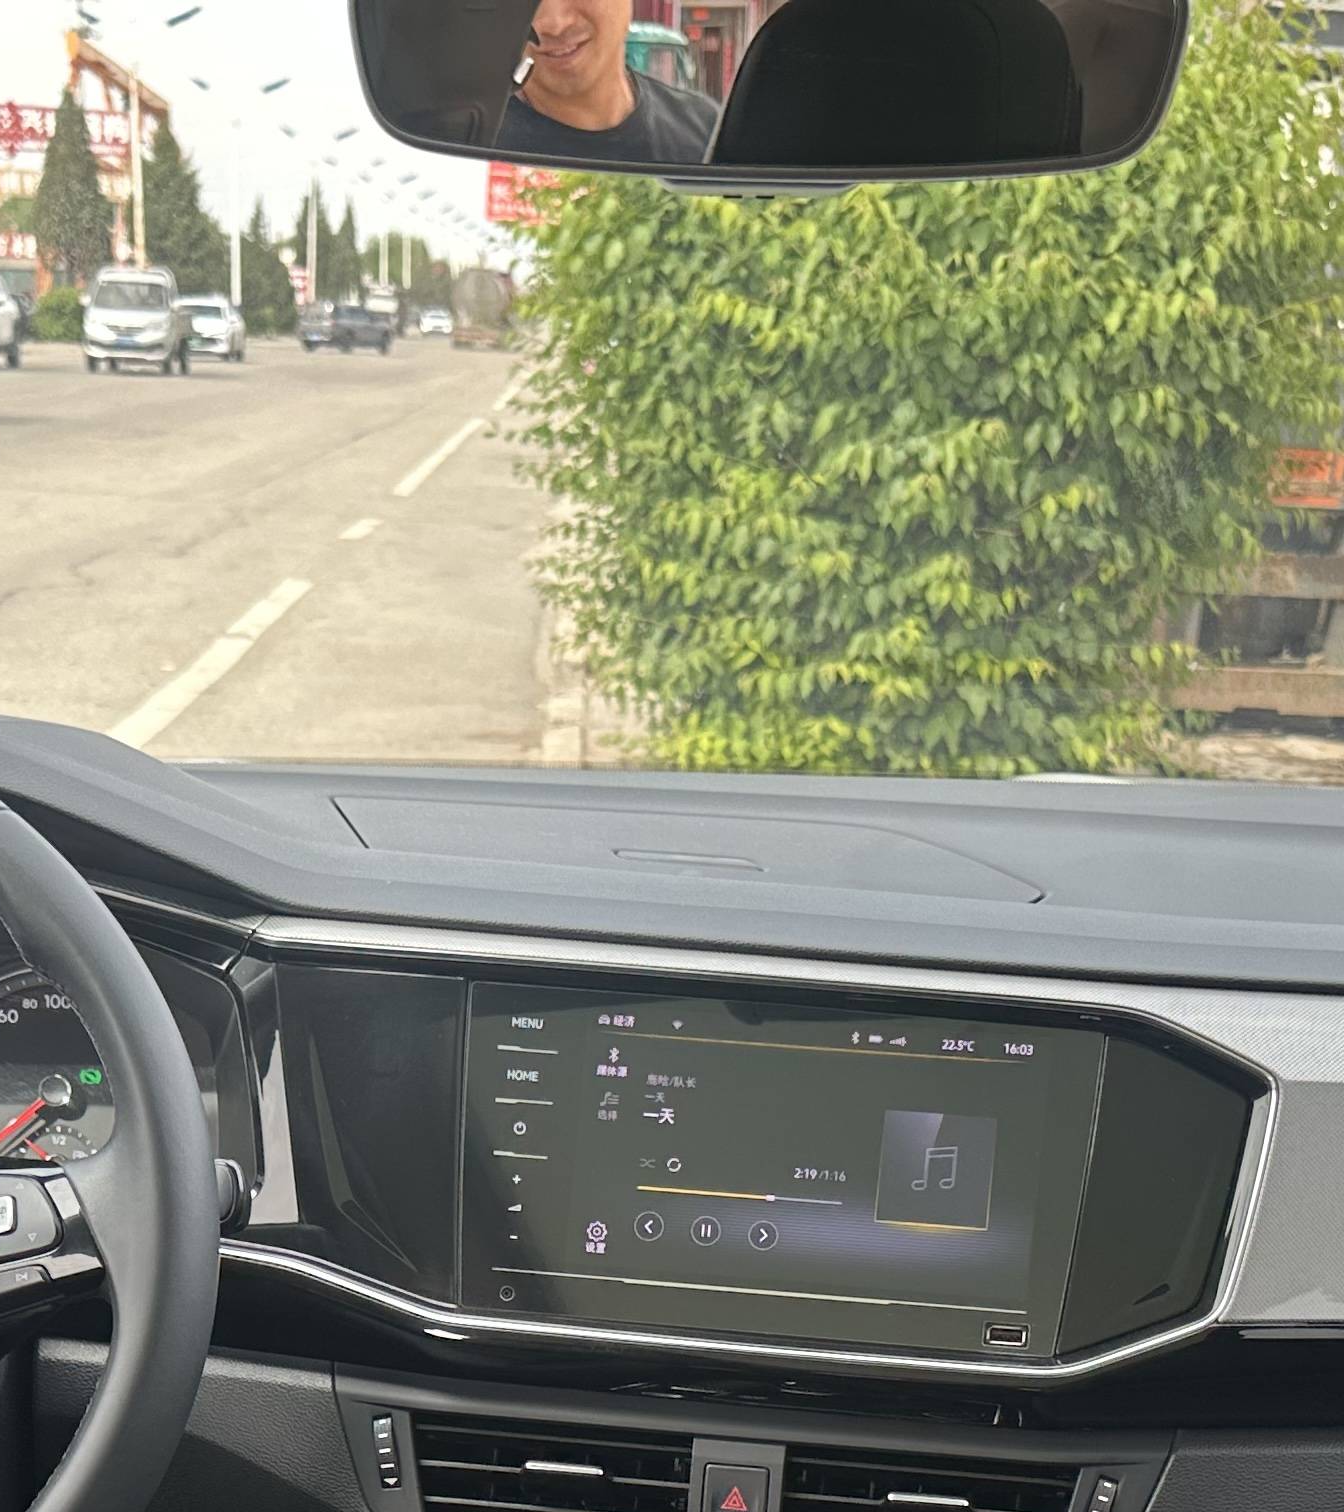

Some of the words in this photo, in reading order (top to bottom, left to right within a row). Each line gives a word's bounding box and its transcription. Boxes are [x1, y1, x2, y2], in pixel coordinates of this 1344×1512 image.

[22, 998, 38, 1009] 80
[44, 994, 73, 1009] 100
[511, 1016, 544, 1030] MENU
[1003, 1043, 1034, 1056] 16:03
[506, 1069, 540, 1083] HOME
[643, 1091, 665, 1103] 一天
[643, 1107, 675, 1125] 一天
[585, 1241, 607, 1254] 设置
